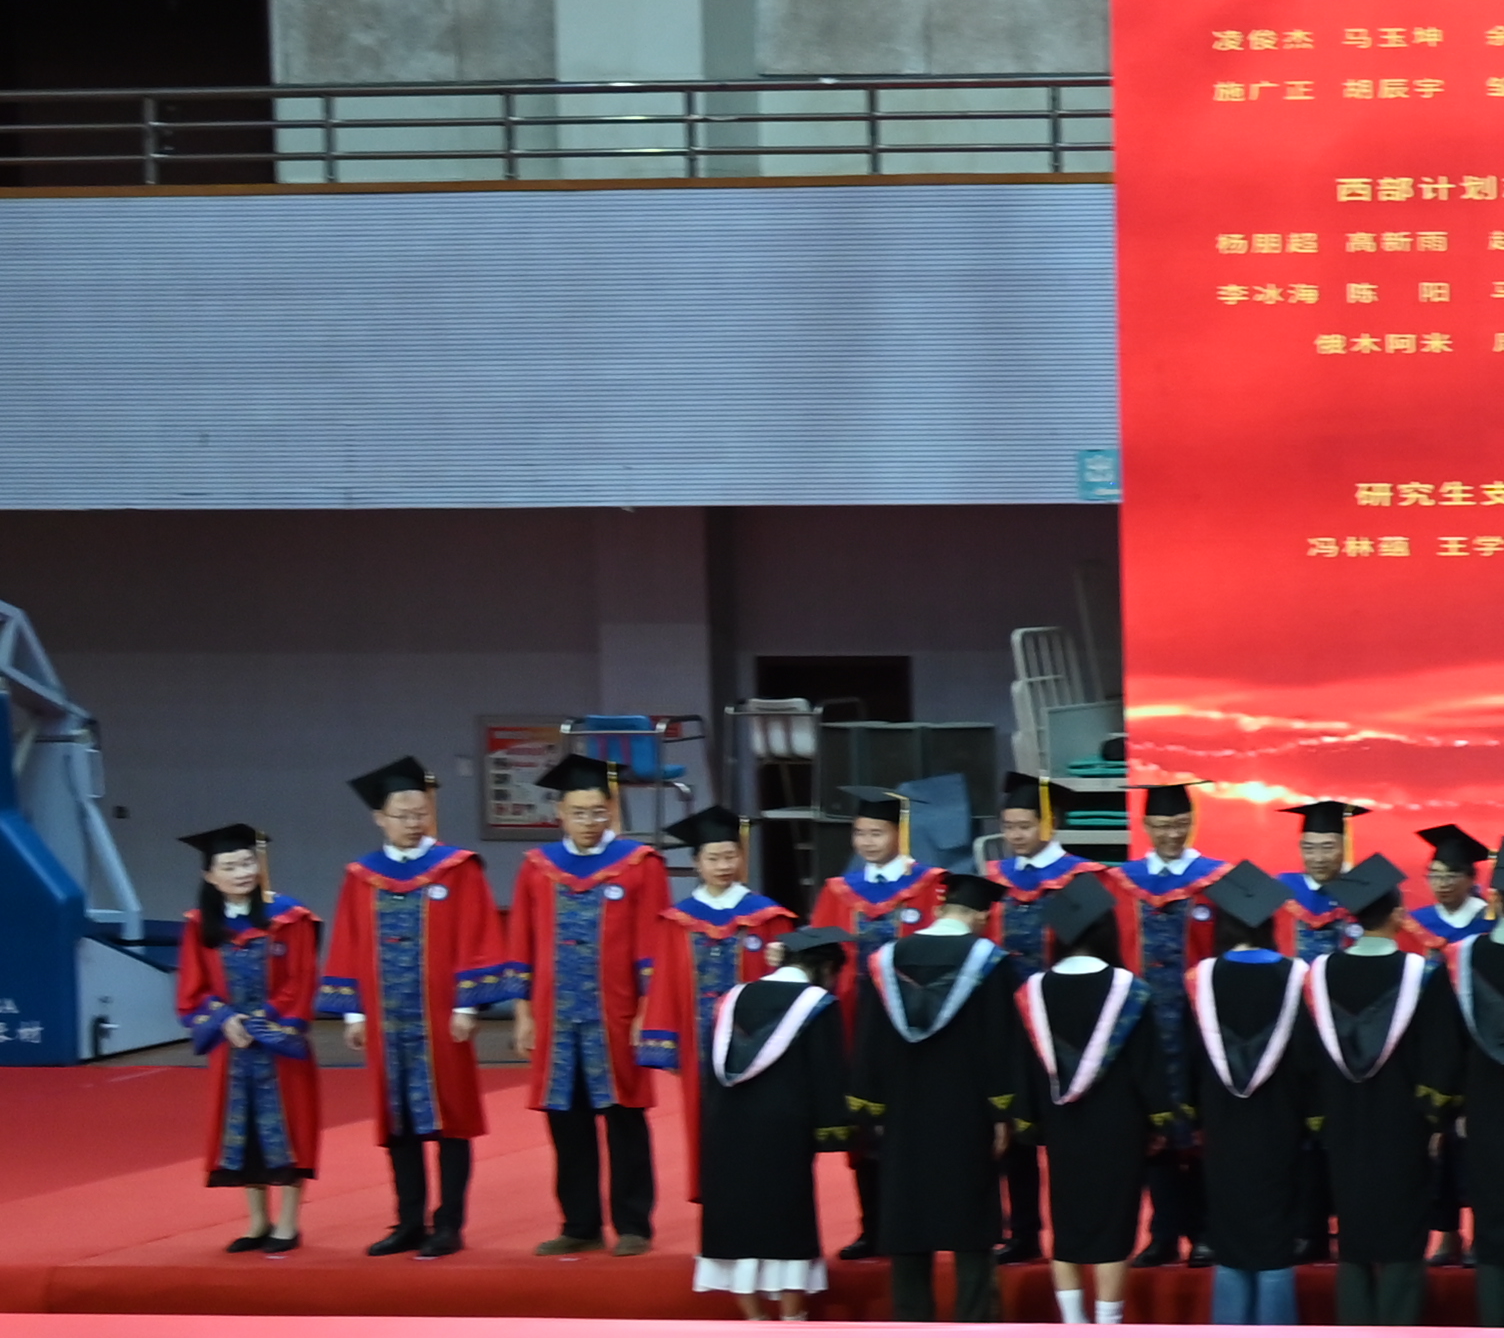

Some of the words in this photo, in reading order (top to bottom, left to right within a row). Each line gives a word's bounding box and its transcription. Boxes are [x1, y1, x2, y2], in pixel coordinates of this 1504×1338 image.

[1342, 27, 1443, 49] 马玉坤
[1346, 231, 1448, 253] 高新雨
[1217, 283, 1320, 305] 李冰海
